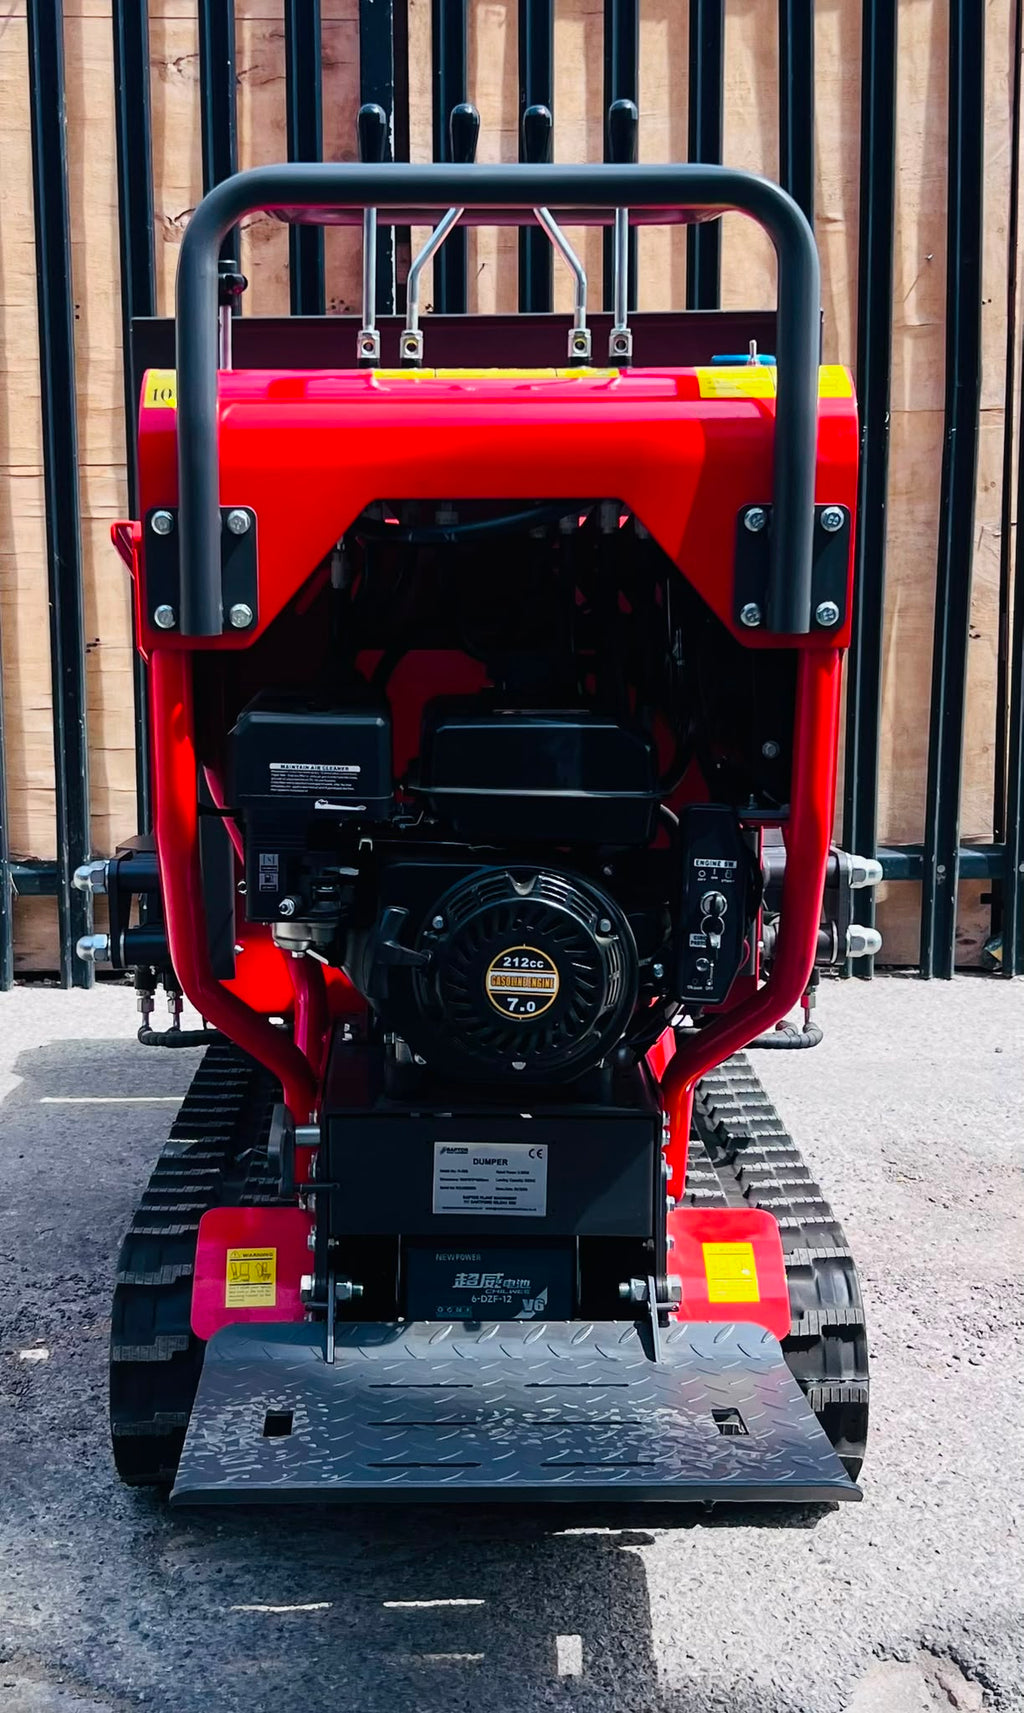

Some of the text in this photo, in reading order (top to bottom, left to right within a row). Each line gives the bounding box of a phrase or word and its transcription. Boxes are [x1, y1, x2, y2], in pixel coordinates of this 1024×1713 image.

[695, 859, 721, 867] ENGINE
[503, 957, 544, 969] 212cc
[491, 975, 555, 989] GASOLINE ENGINE
[507, 998, 536, 1012] 7.0
[472, 1158, 509, 1166] DUMPER
[452, 1272, 531, 1289] 超威电池
[471, 1295, 513, 1303] 6-DZF-12
[522, 1298, 545, 1312] V6
